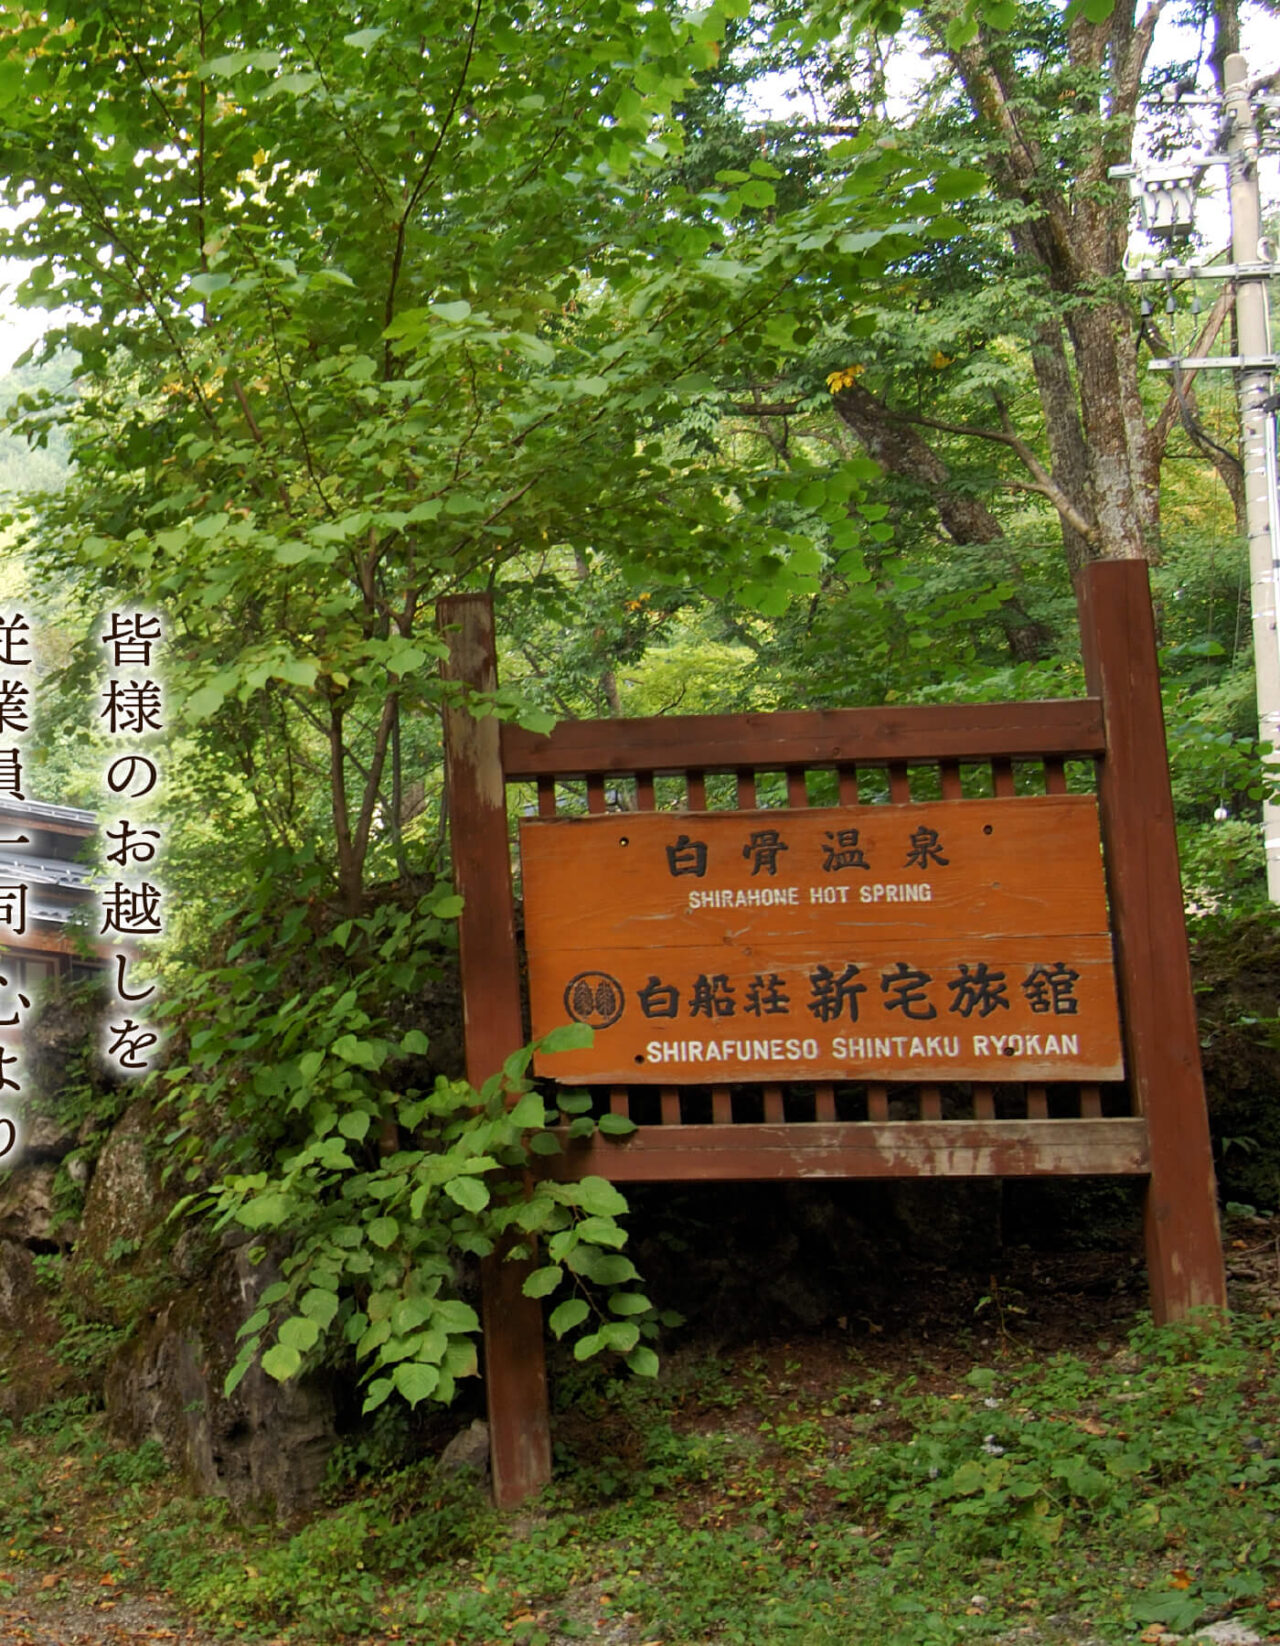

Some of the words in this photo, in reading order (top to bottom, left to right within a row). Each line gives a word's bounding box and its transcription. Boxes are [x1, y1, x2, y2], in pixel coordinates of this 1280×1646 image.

[666, 825, 950, 877] 白骨温泉
[688, 887, 799, 909] SHIRAHONE
[810, 886, 850, 904] HOT
[860, 883, 932, 903] SPRING
[646, 1039, 819, 1063] SHIRAFUNESO
[832, 1036, 959, 1059] SHINTAKU
[973, 1034, 1079, 1057] RYOKAN
